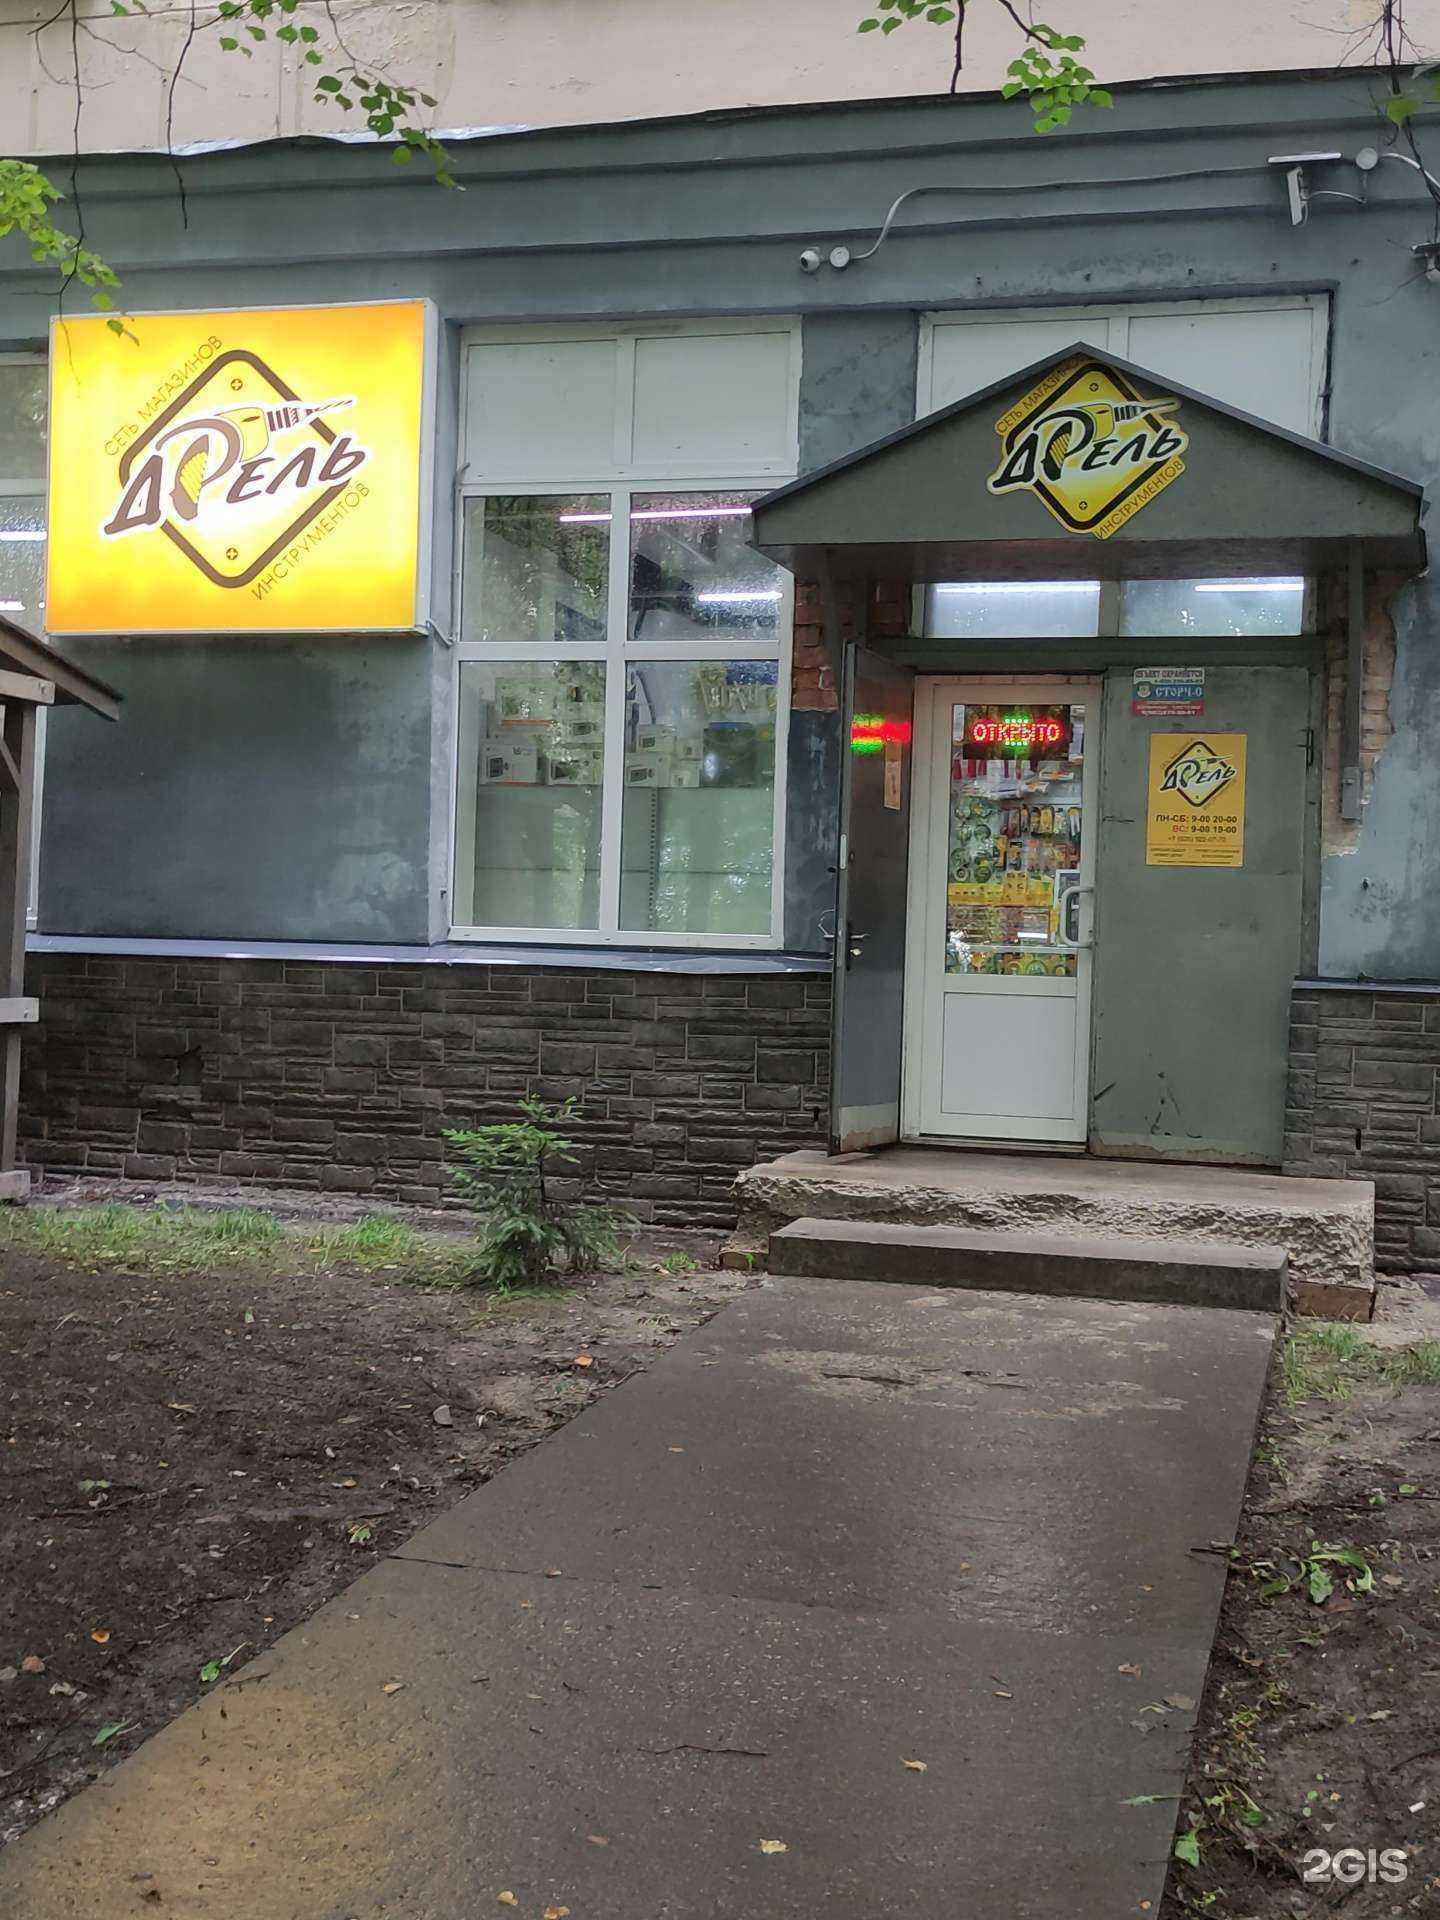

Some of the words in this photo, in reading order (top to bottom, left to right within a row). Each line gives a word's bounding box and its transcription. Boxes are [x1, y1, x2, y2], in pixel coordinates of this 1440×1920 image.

[105, 423, 139, 455] СЕТЬ
[138, 335, 223, 421] МАГАЗИНОВ
[997, 411, 1023, 434] СЕТЬ
[1095, 460, 1184, 538] ИНСТРУМЕНТОВ
[251, 483, 370, 601] ИНСТРУМЕНТОВ
[973, 723, 1060, 741] ОТКРЫТО
[1156, 814, 1189, 823] ПН-СБ:
[1191, 815, 1211, 823] 9-00
[1212, 815, 1238, 824] 20-00
